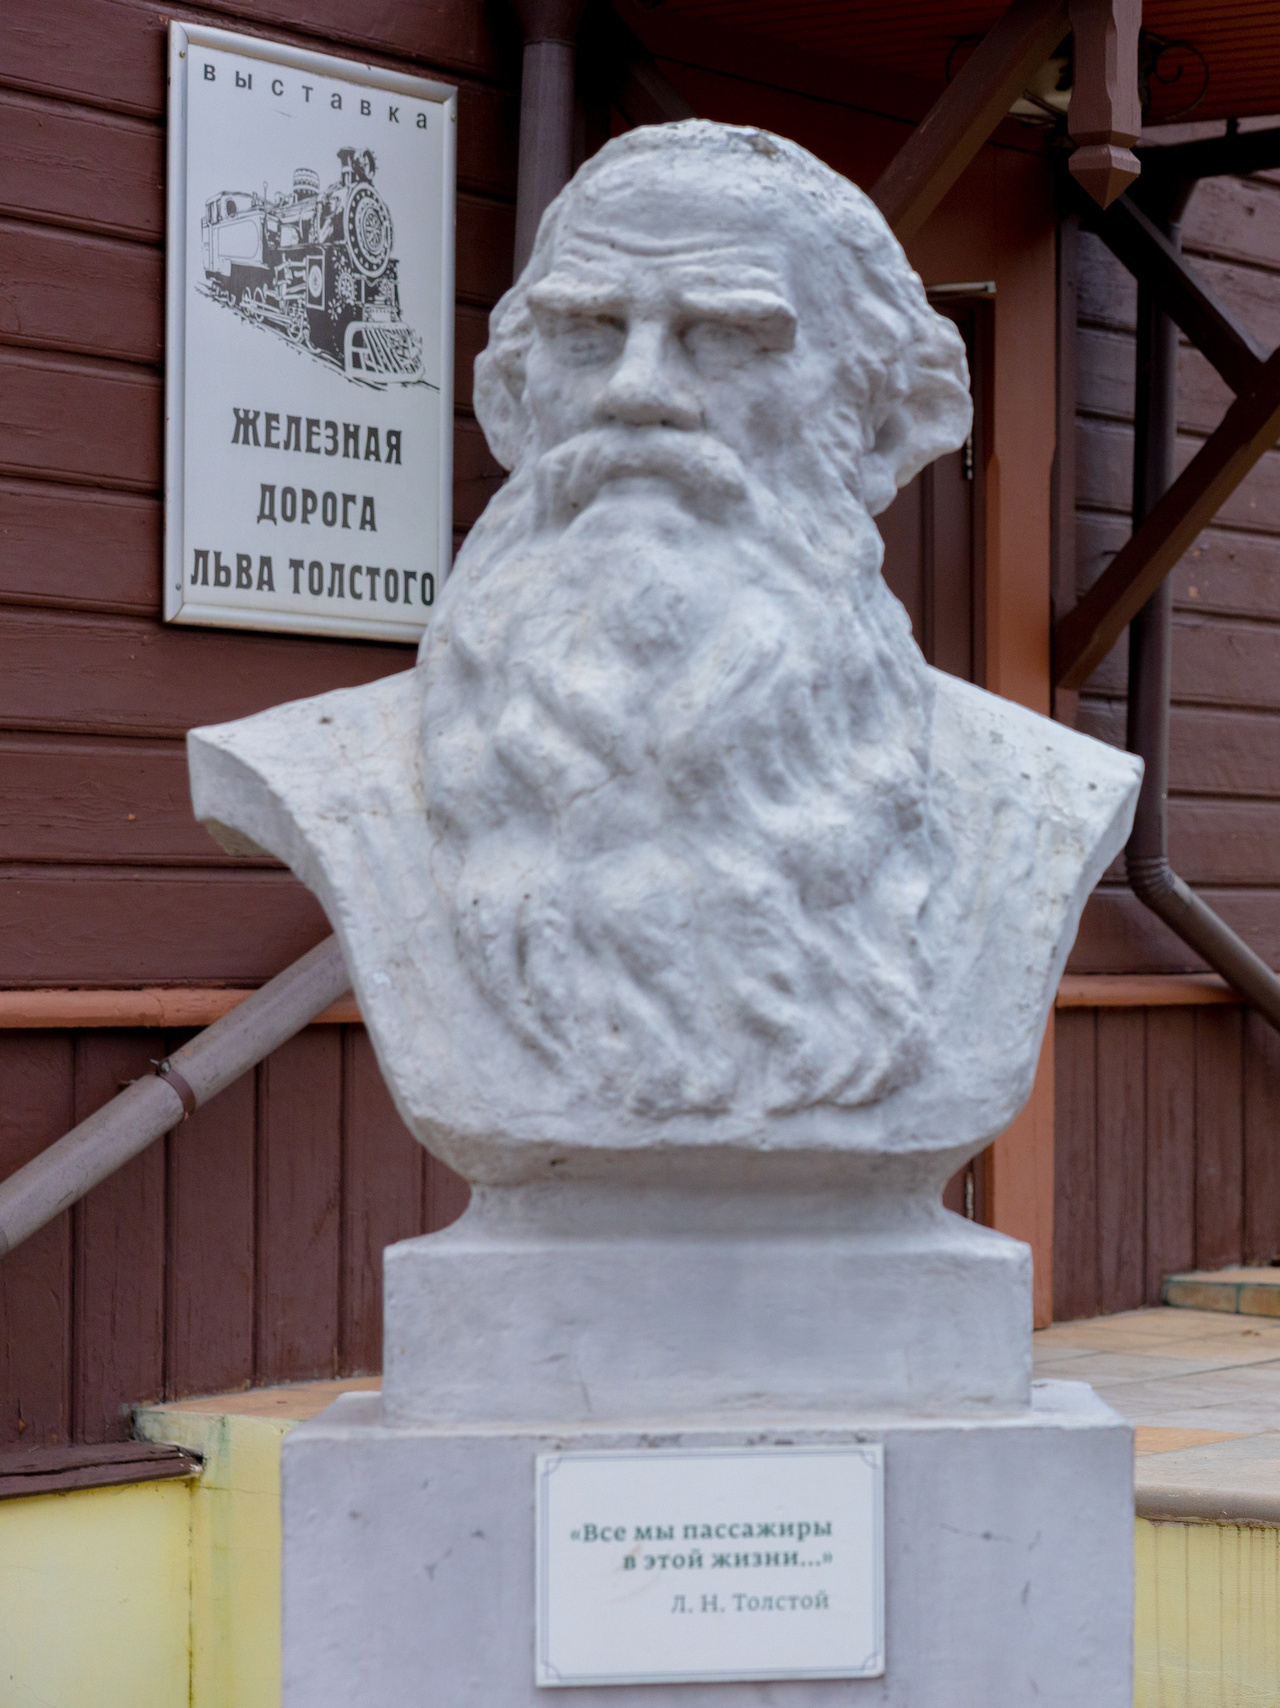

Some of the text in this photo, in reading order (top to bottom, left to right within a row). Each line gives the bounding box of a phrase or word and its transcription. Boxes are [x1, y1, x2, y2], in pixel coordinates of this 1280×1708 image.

[231, 407, 403, 466] ЖЕЛЕЗНАЯ
[256, 483, 378, 532] ДОРОГА
[190, 548, 435, 607] ЛЬВА ТОЛСТОГО
[570, 1520, 833, 1542] «Все мы пассажиры
[623, 1554, 637, 1571] в
[644, 1549, 703, 1570] этой
[732, 1590, 830, 1612] Толстой
